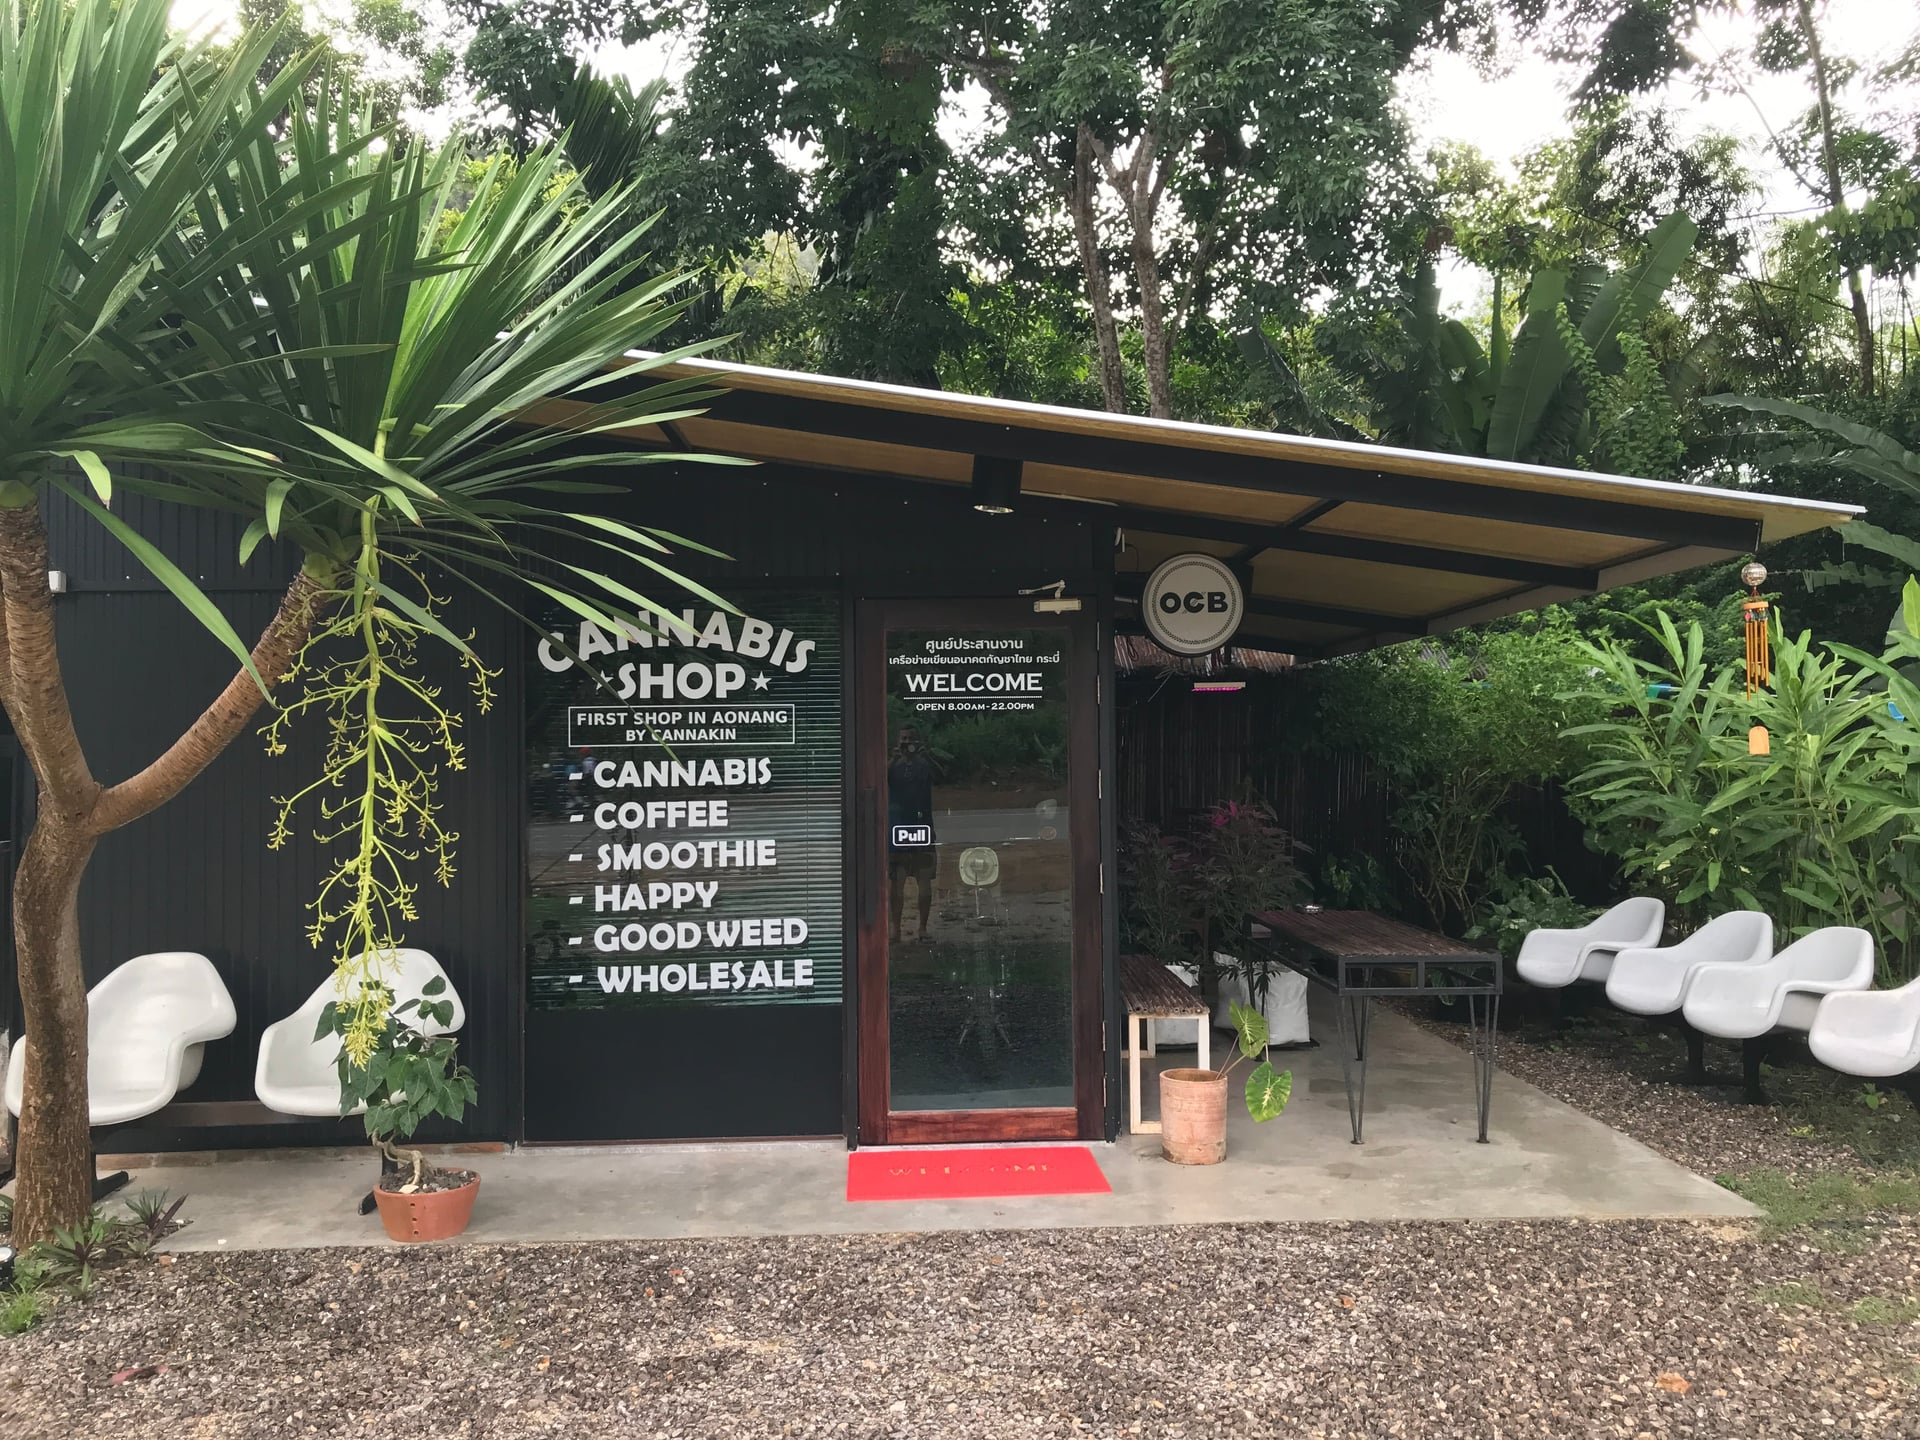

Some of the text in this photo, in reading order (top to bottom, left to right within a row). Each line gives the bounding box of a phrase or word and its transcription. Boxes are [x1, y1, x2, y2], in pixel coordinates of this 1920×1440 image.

[1160, 591, 1228, 614] OCB
[537, 608, 816, 673] CANNABIS
[925, 638, 1023, 653] ศูนย์ประสานงาน
[617, 662, 746, 699] SHOP
[905, 672, 1043, 693] WELCOME
[577, 710, 788, 726] FIRST SHOP IN AONANG
[916, 703, 946, 711] OPEN
[625, 728, 736, 742] BY CANNAKIN
[593, 757, 772, 788] CANNABIS
[594, 800, 728, 829] COFFEE
[898, 830, 926, 842] Pull
[597, 839, 777, 872] SMOOTHIE
[594, 881, 719, 912] HAPPY
[594, 921, 702, 952] GOOD
[706, 917, 809, 948] WEED
[597, 958, 814, 993] WHOLESALE
